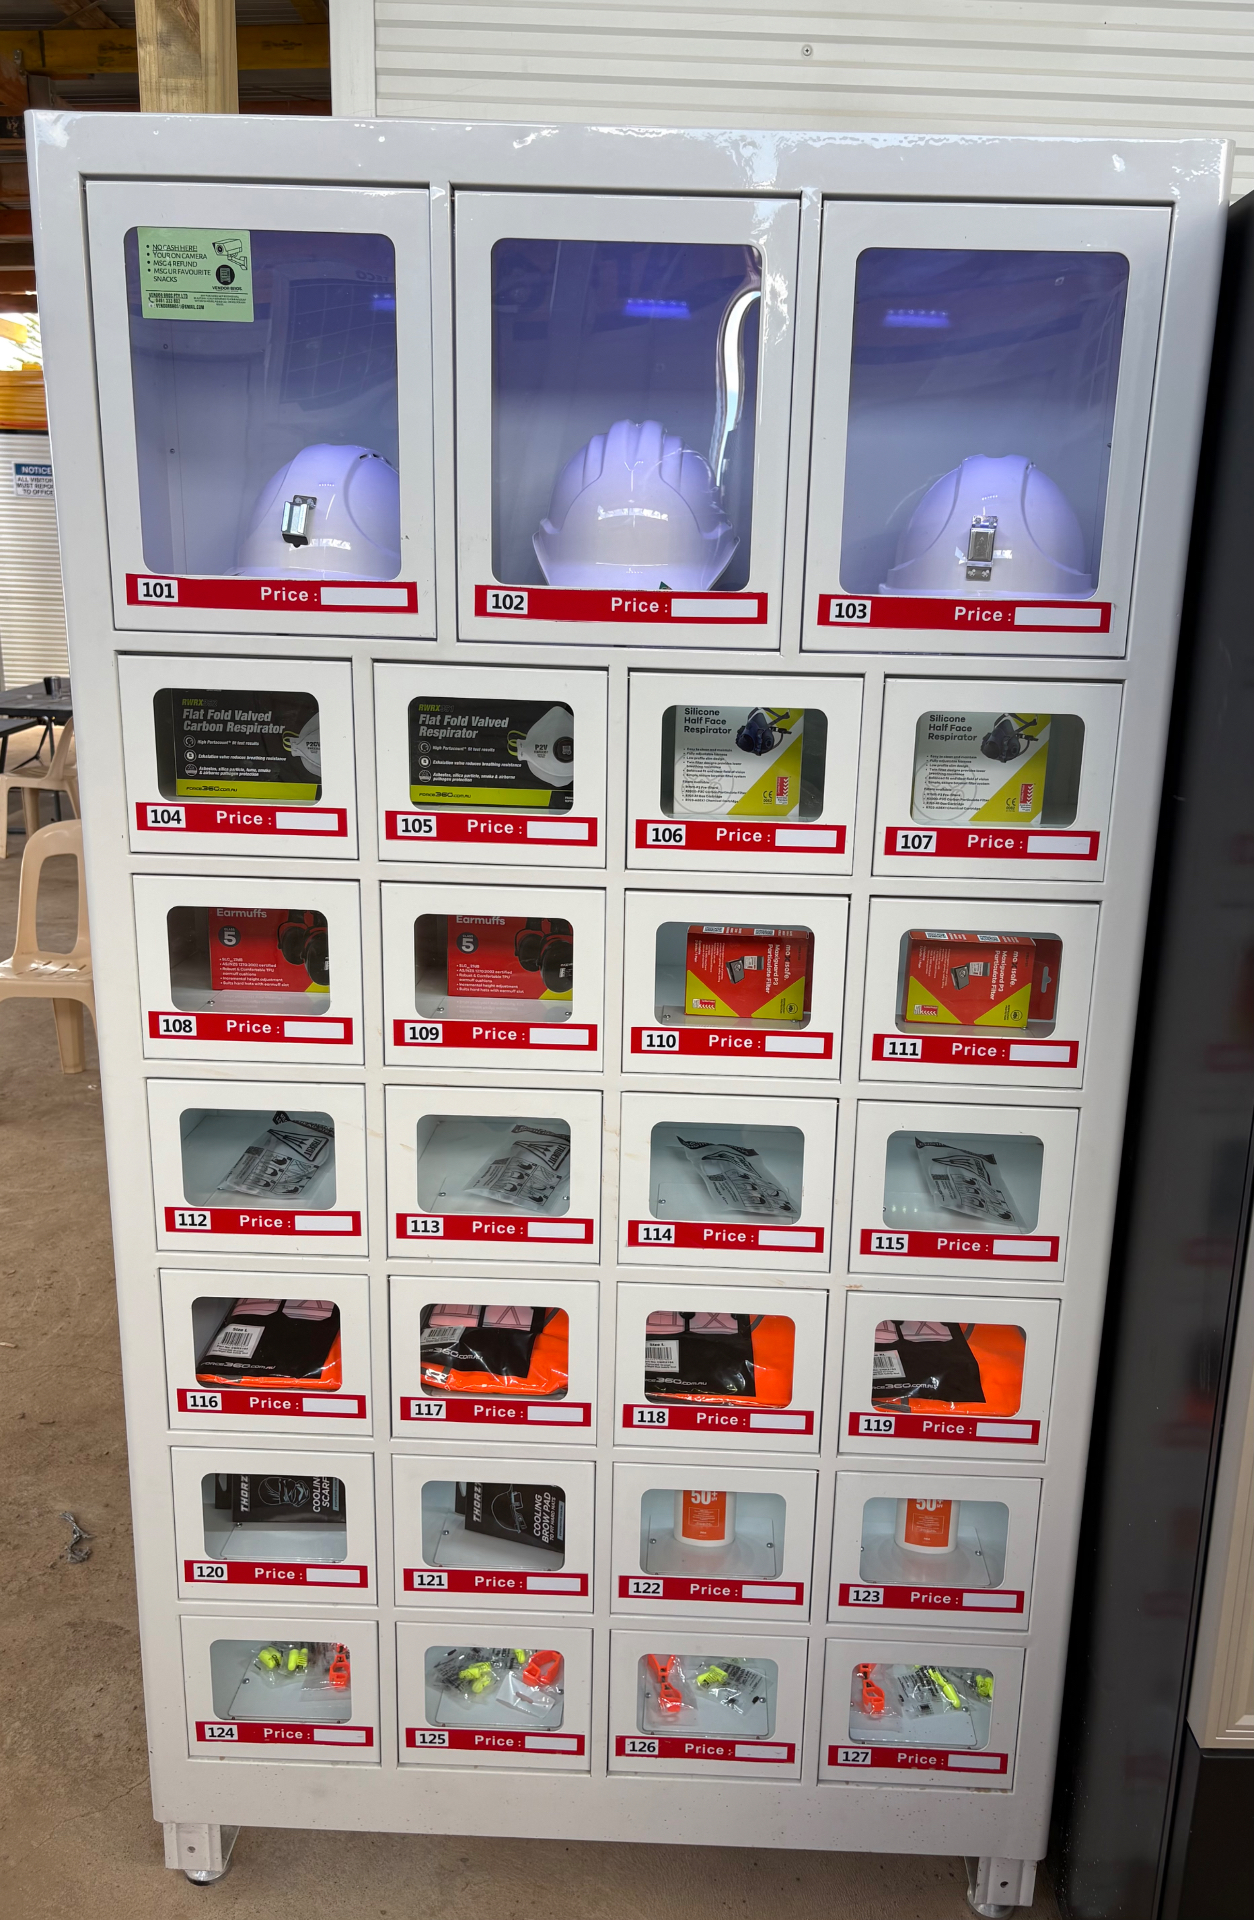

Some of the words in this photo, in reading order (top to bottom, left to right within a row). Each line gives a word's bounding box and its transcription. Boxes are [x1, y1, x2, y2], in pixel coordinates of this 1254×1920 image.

[22, 466, 52, 474] NOTICE
[142, 582, 174, 598] 101
[492, 594, 524, 610] 102
[834, 602, 866, 620] 103
[182, 709, 204, 720] Flat
[207, 710, 231, 720] Fold
[234, 710, 272, 722] Valved
[684, 707, 720, 716] Silicone
[419, 714, 441, 725] Flat
[444, 715, 468, 726] Fold
[472, 716, 509, 728] Valved
[684, 717, 703, 725] Half
[930, 714, 966, 723] Silicone
[184, 721, 223, 732] Carbon
[226, 722, 285, 735] Respirator
[419, 726, 478, 739] Respirator
[684, 726, 732, 734] Respirator
[928, 733, 977, 742] Respirator
[150, 810, 182, 824] 104
[402, 818, 432, 834] 105
[652, 828, 682, 842] 106
[900, 834, 932, 850] 107
[216, 908, 267, 918] Earmuffs
[456, 915, 505, 925] Earmuffs
[223, 932, 237, 945] 5
[461, 938, 474, 952] 5
[992, 950, 1000, 983] Particulate
[999, 950, 1007, 983] Maxiguard
[162, 1018, 192, 1034] 108
[410, 1026, 440, 1040] 109
[646, 1034, 676, 1048] 110
[888, 1042, 918, 1056] 111
[178, 1214, 208, 1226] 112
[412, 1220, 440, 1234] 113
[644, 1228, 672, 1240] 114
[876, 1236, 904, 1250] 115
[190, 1396, 218, 1408] 116
[414, 1404, 442, 1416] 117
[638, 1410, 666, 1424] 118
[864, 1418, 892, 1432] 119
[534, 1494, 542, 1536] COOLING
[542, 1512, 550, 1543] BROW
[196, 1566, 224, 1578] 120
[418, 1574, 444, 1586] 121
[634, 1582, 660, 1594] 122
[852, 1590, 880, 1602] 123
[208, 1726, 234, 1738] 124
[420, 1734, 446, 1744] 125
[630, 1740, 656, 1752] 126
[842, 1750, 870, 1762] 127
